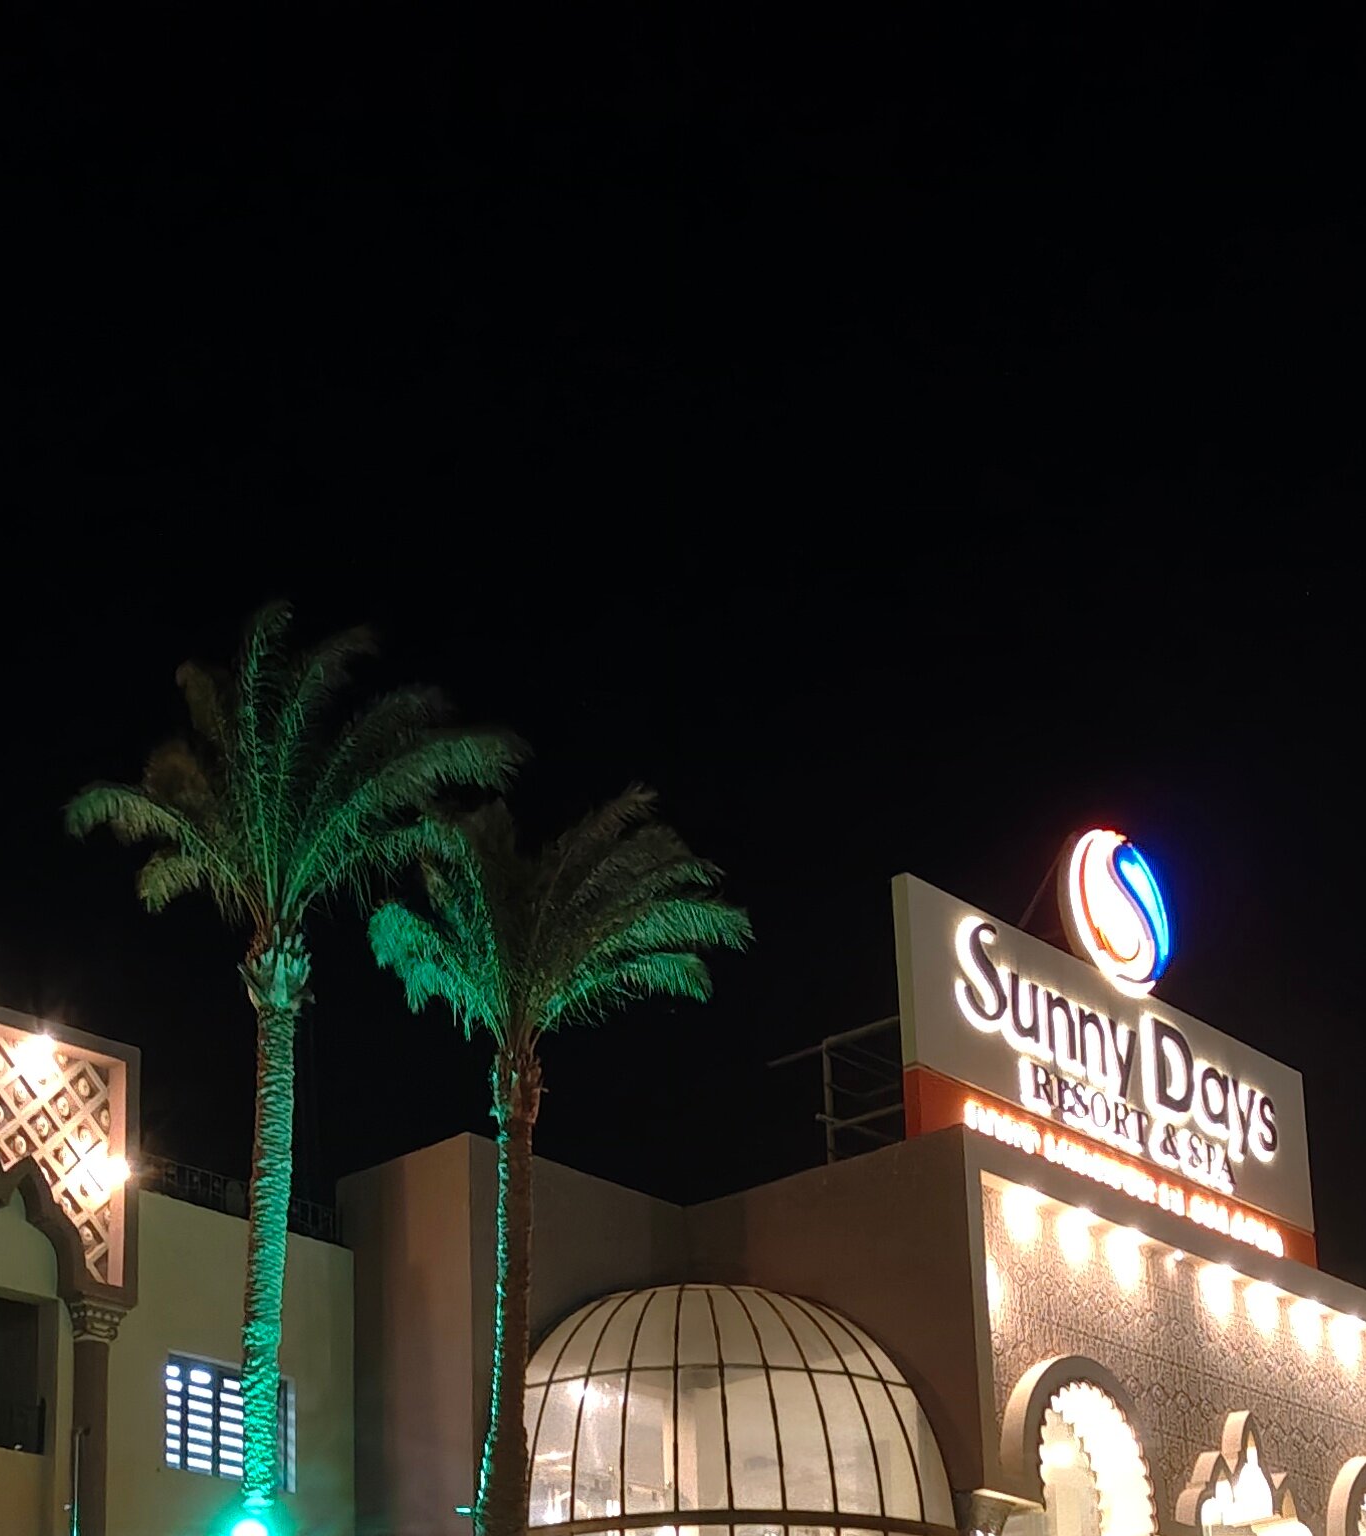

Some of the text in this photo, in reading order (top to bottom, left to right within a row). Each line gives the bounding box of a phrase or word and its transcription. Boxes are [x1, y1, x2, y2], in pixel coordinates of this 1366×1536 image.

[964, 922, 1278, 1155] Sunny Days
[1029, 1061, 1237, 1187] RESORT & SPA
